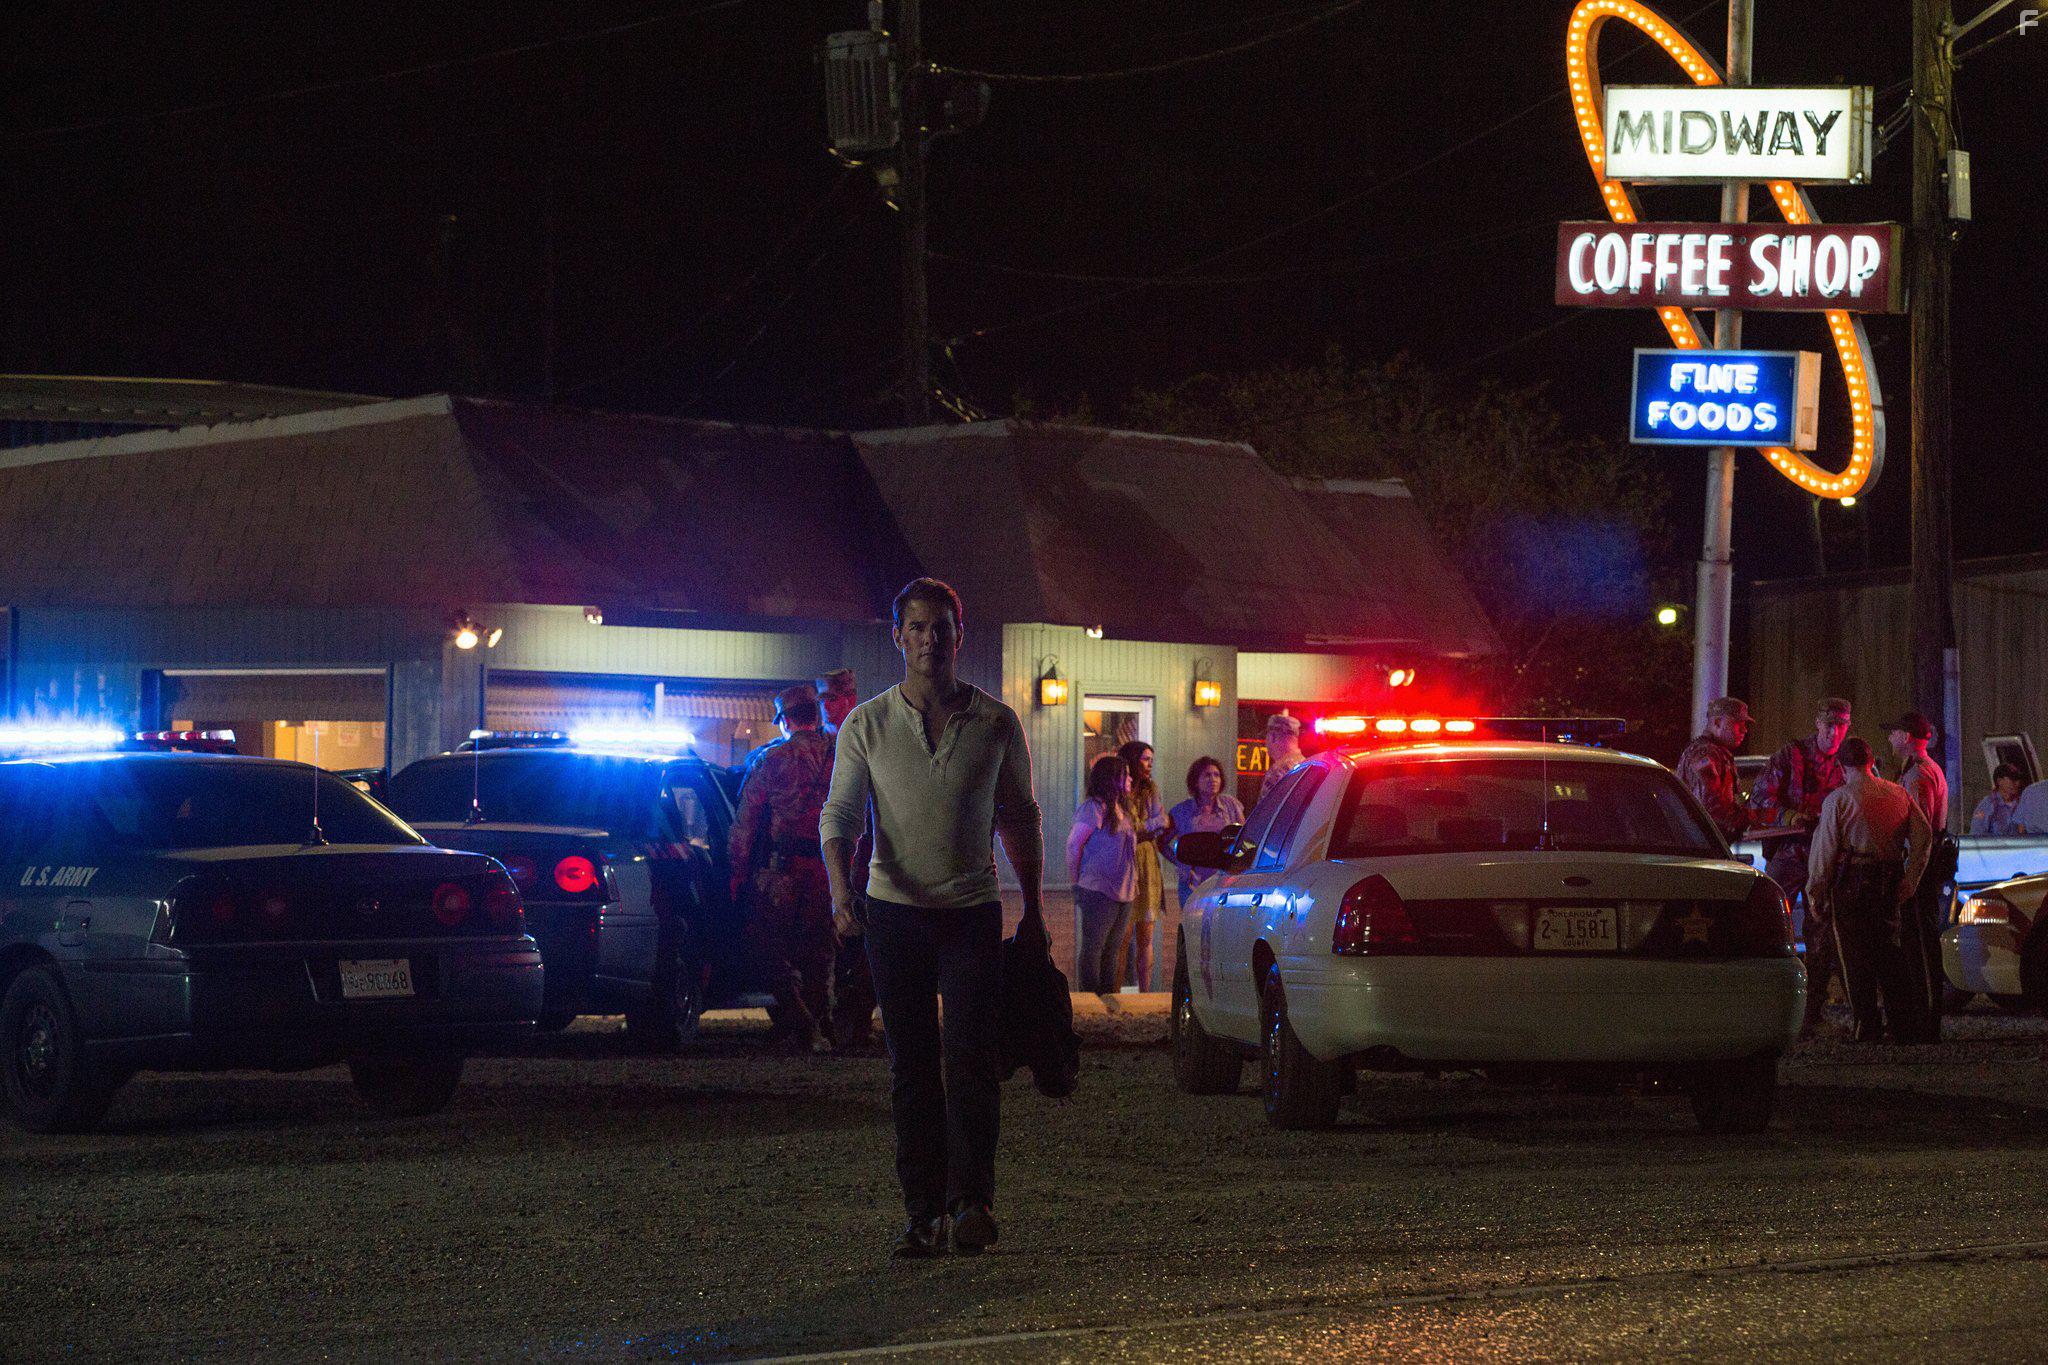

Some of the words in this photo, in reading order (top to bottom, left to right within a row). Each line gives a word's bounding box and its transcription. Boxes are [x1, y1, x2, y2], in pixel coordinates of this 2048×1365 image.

[1613, 110, 1842, 156] MIDWAY
[1568, 233, 1733, 296] COFFEE
[1748, 234, 1881, 298] SHOP
[1670, 363, 1759, 394] FINE
[1648, 401, 1777, 432] FOODS
[50, 866, 99, 886] ARMY
